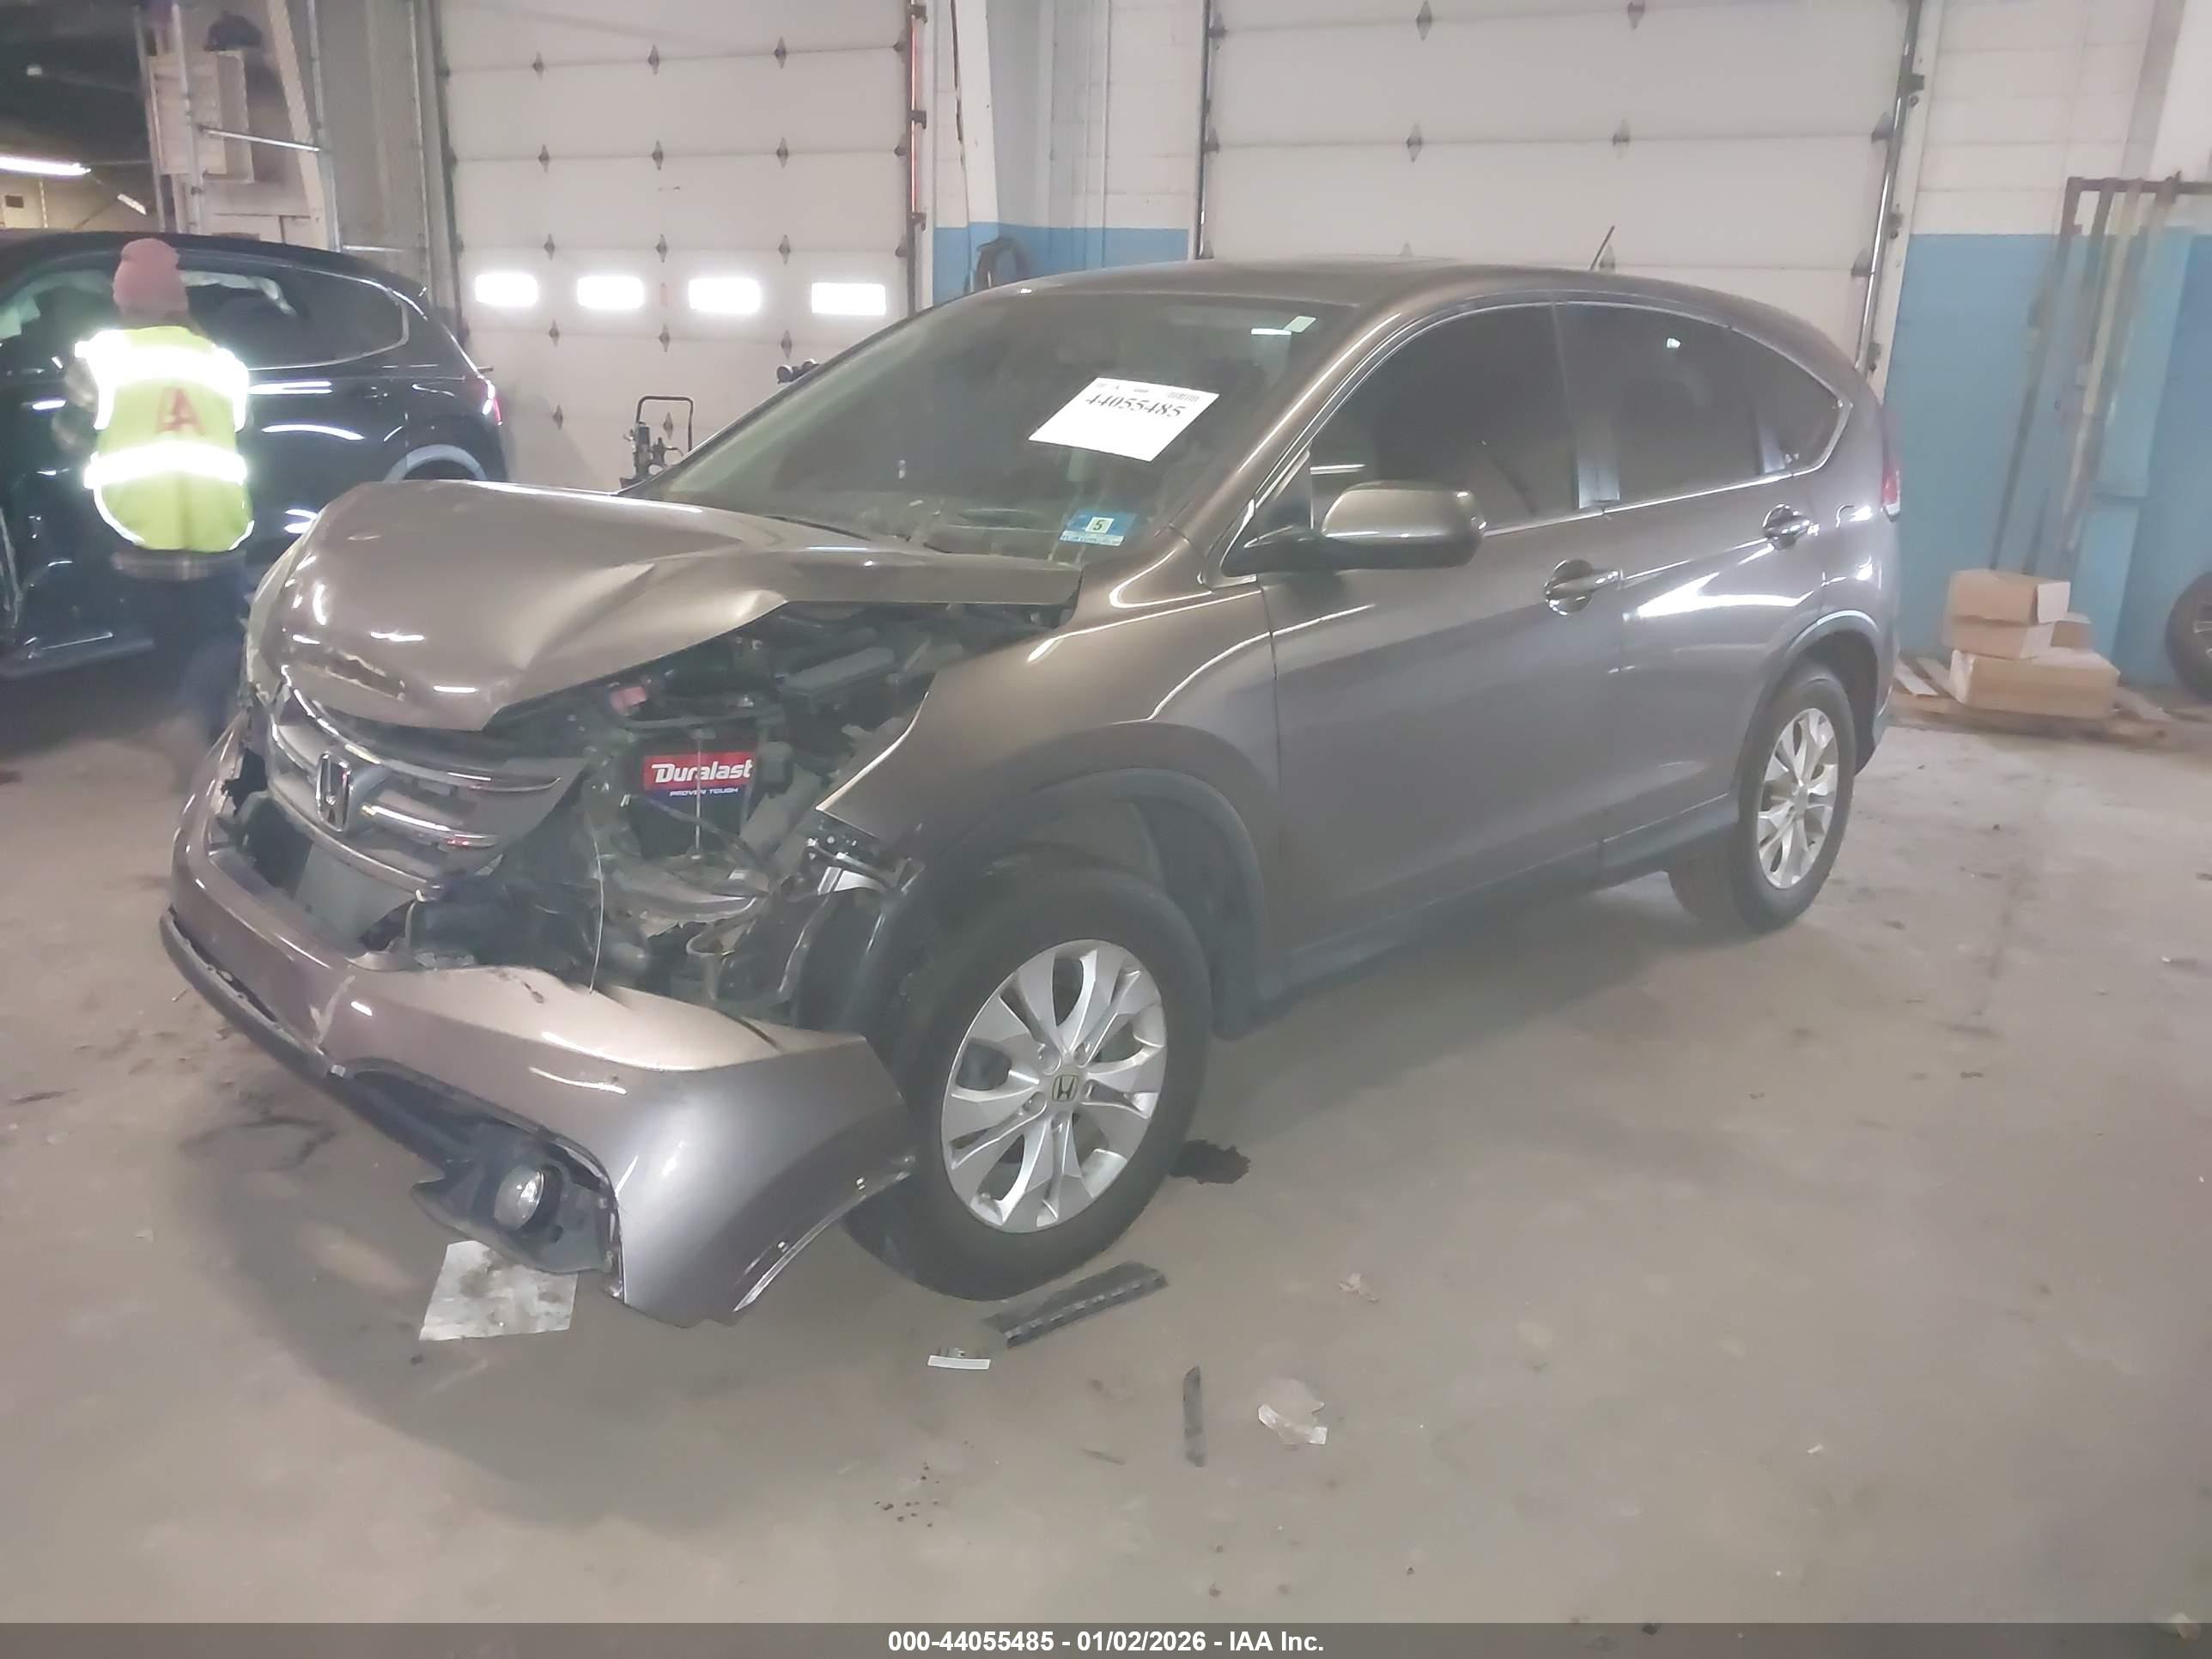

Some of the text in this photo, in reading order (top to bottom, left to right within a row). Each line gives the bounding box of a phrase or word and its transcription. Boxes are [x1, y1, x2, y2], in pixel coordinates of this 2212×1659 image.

[1085, 392, 1188, 418] 44055485
[1092, 519, 1106, 532] 5
[651, 759, 753, 783] Duralast
